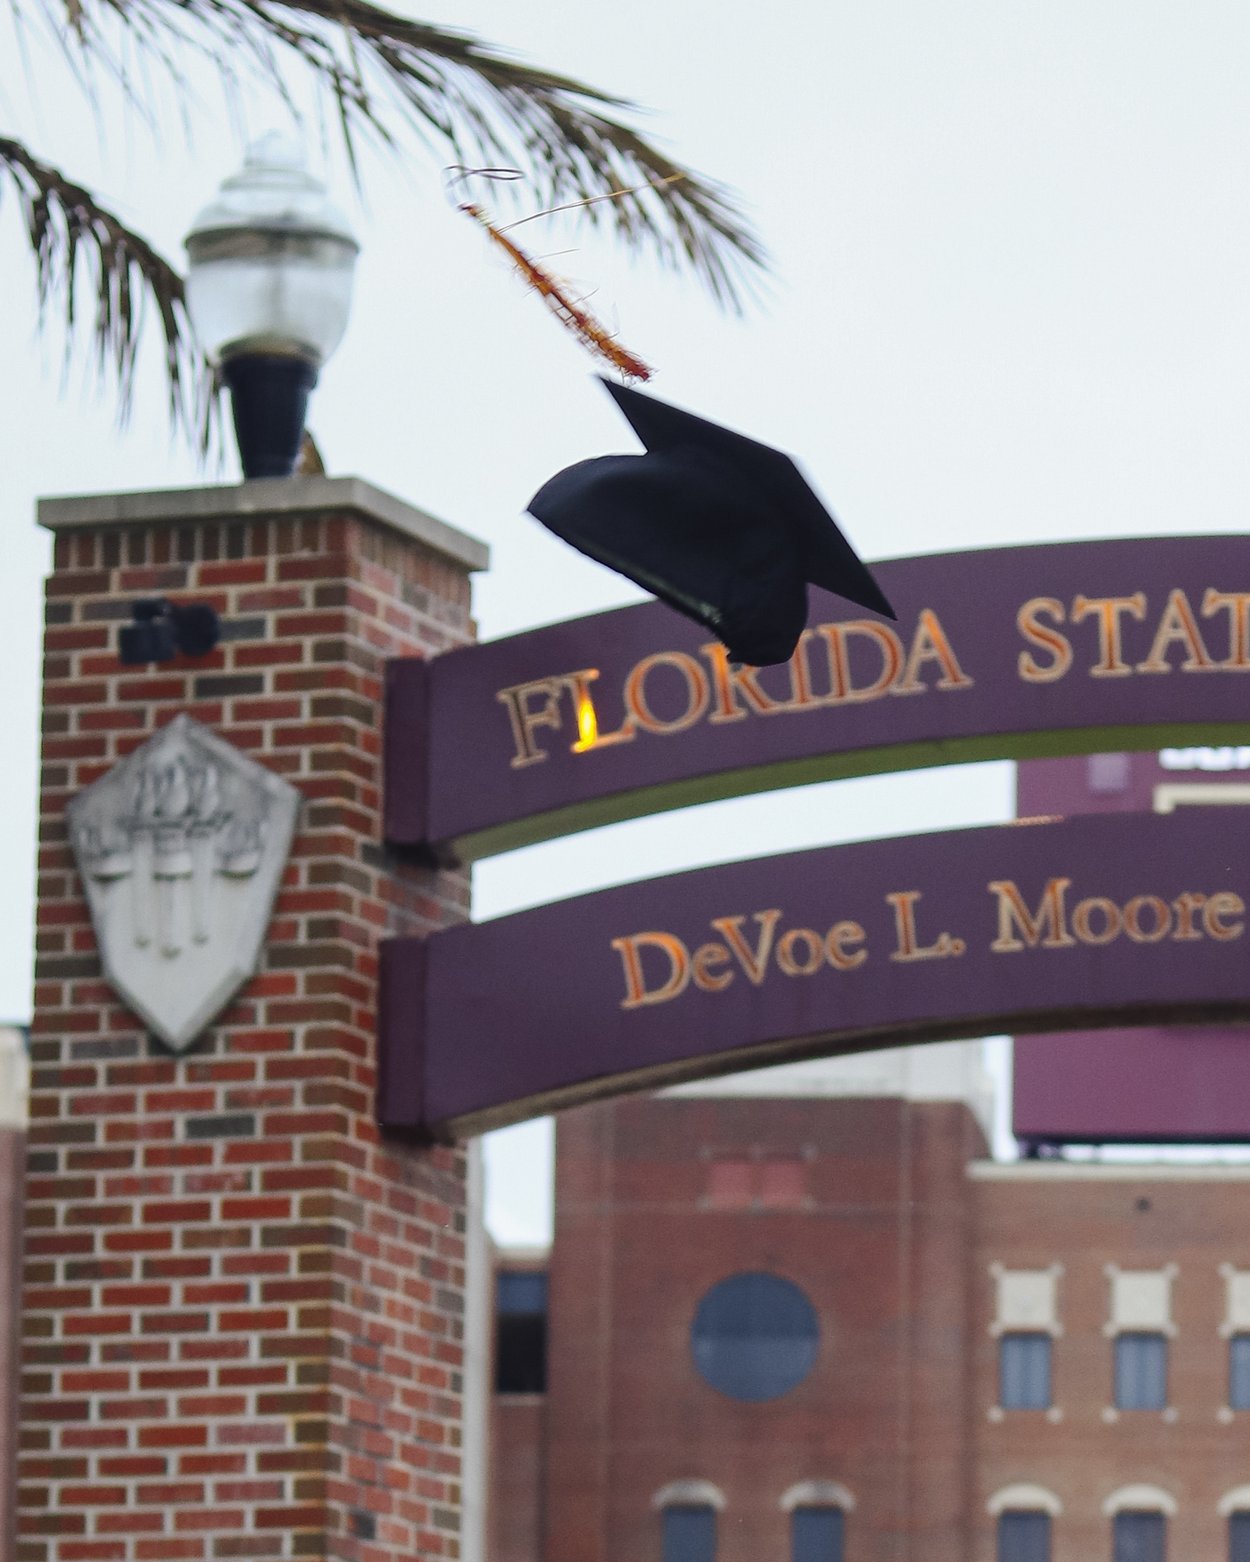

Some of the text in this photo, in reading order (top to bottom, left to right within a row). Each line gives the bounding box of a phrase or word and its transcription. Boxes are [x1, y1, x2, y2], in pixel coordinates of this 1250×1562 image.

[611, 909, 867, 1009] DeVoe
[887, 892, 965, 963] L.
[989, 878, 1245, 952] Moore
